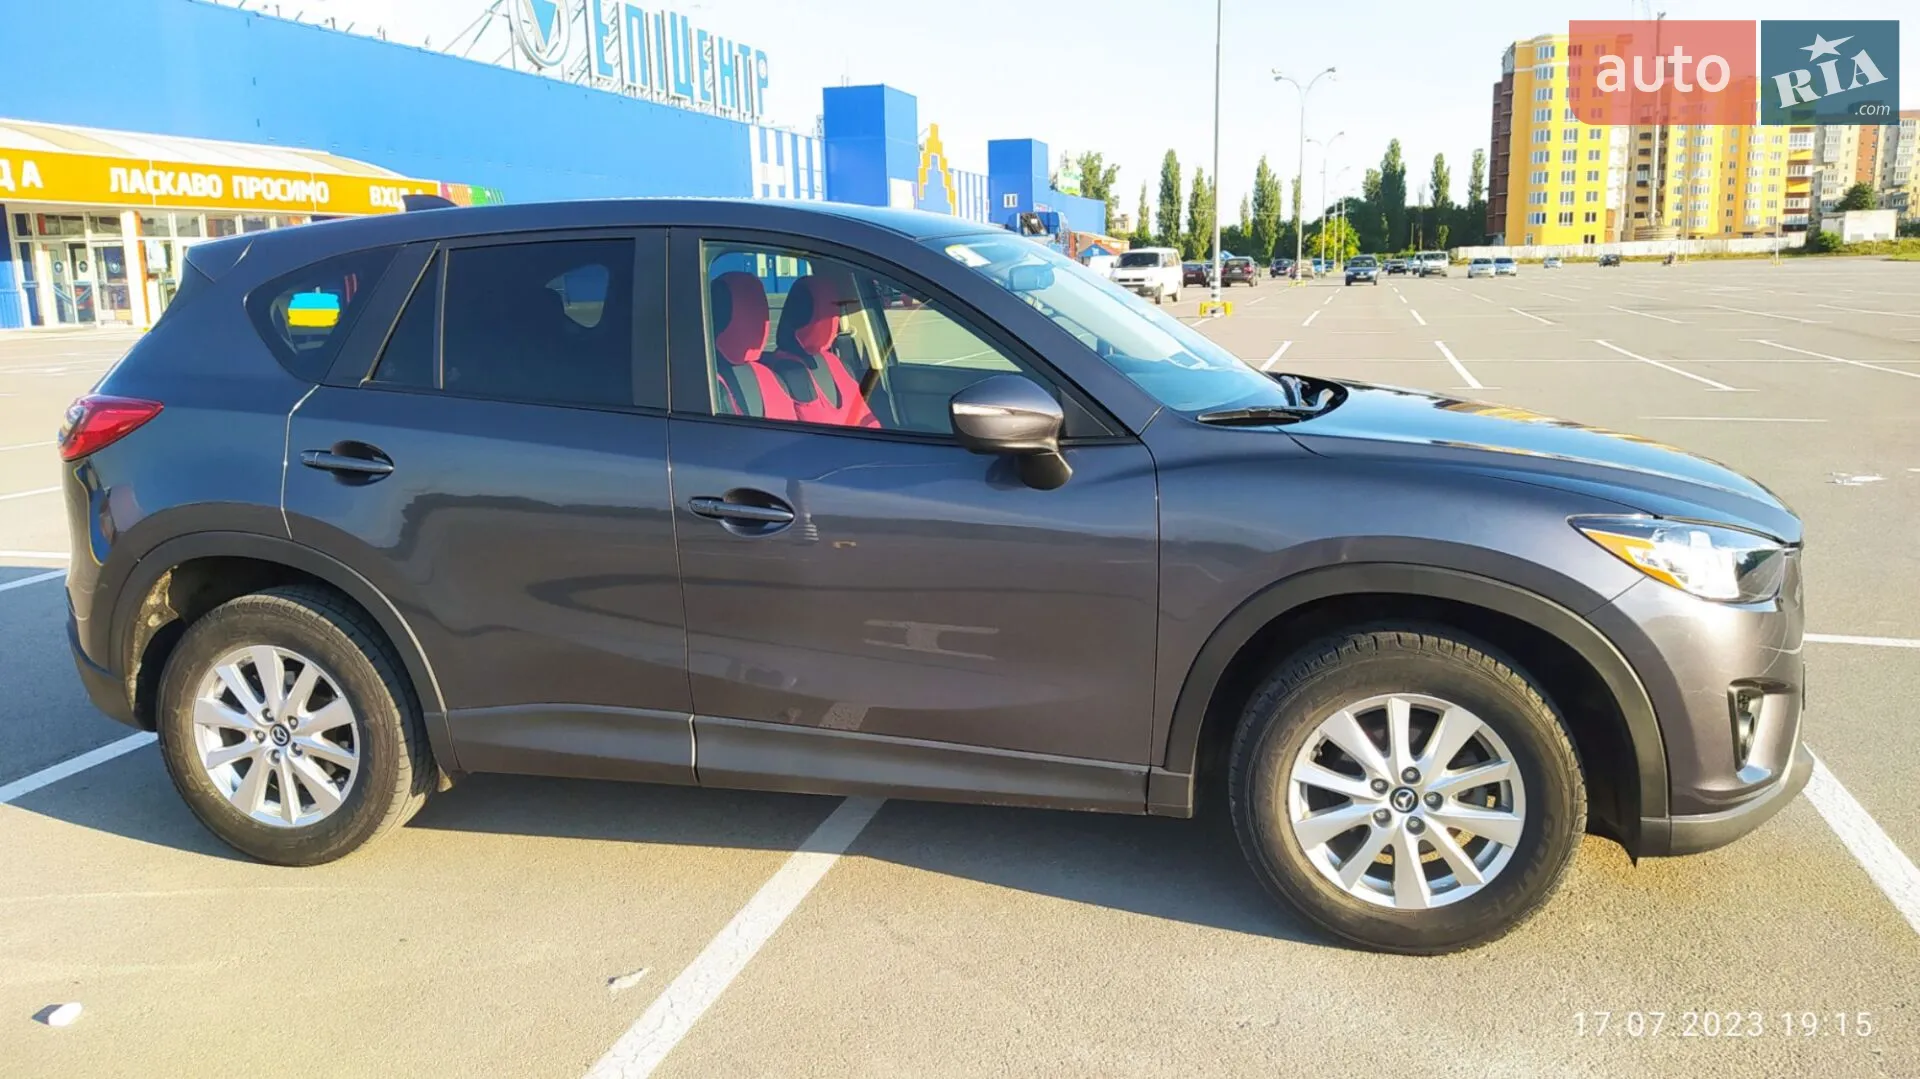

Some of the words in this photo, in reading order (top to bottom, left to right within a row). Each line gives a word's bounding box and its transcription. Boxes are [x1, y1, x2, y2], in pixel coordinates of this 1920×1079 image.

[592, 0, 769, 115] ЕПІЦЕНТР
[109, 167, 223, 198] ЛАСКАВО
[232, 175, 330, 204] ПРОСИМО
